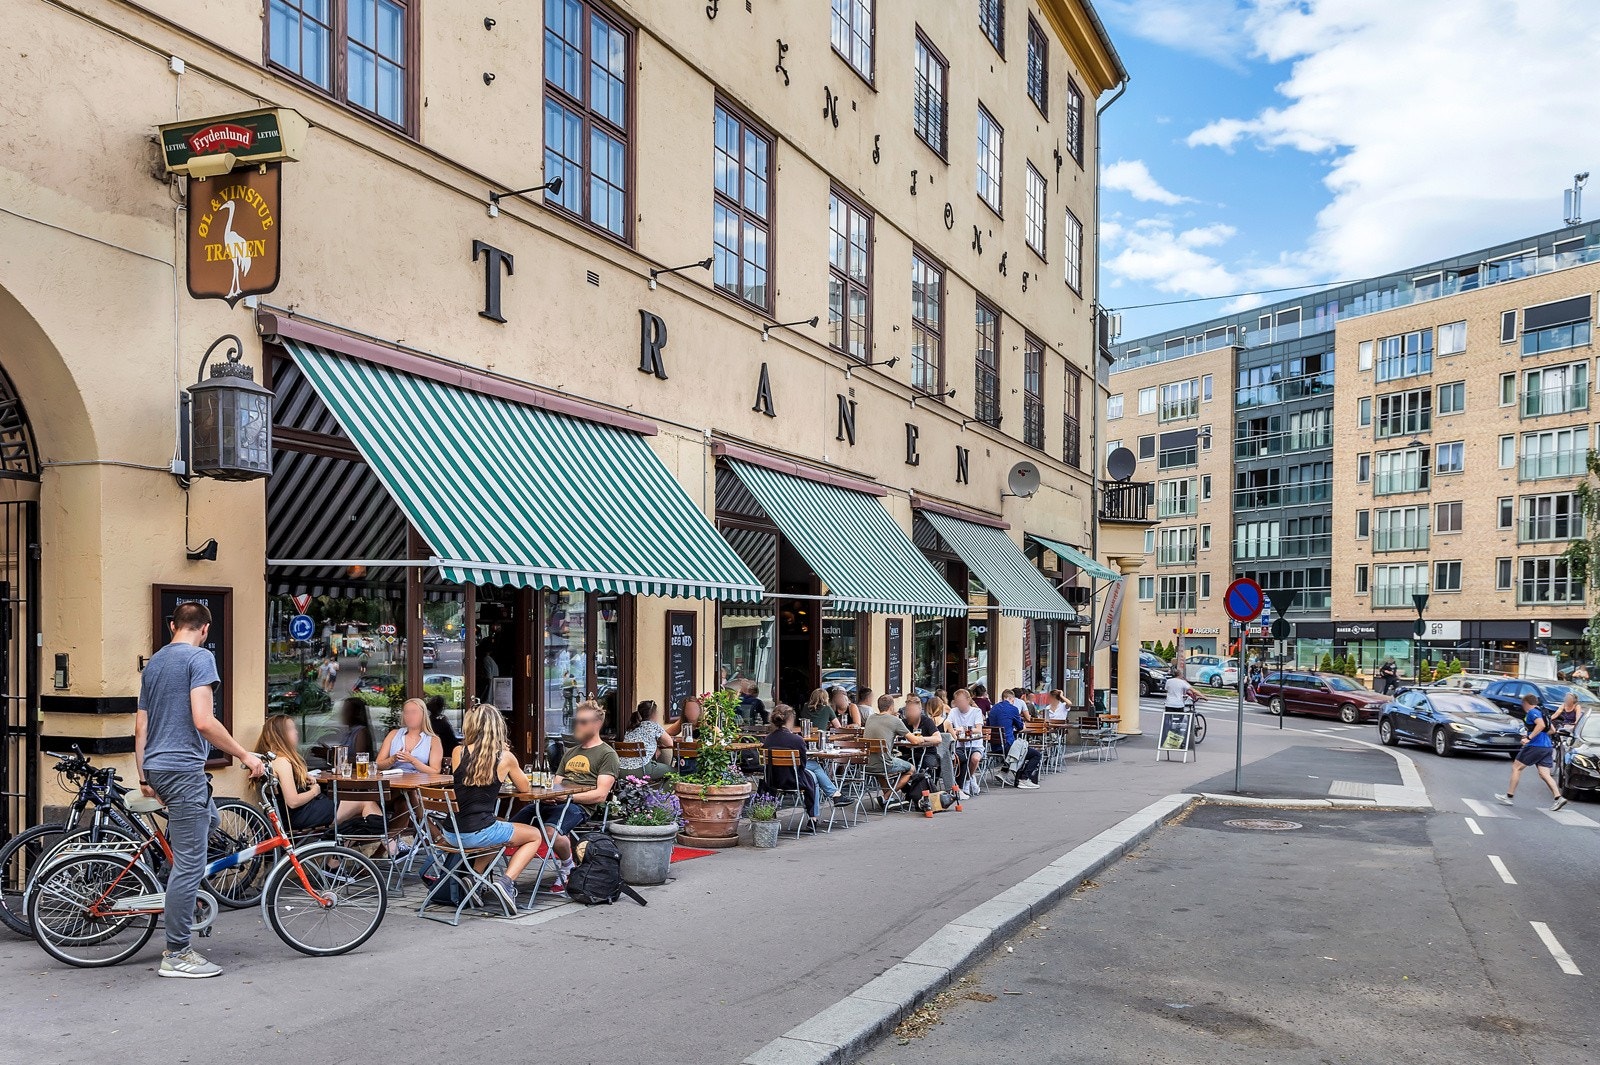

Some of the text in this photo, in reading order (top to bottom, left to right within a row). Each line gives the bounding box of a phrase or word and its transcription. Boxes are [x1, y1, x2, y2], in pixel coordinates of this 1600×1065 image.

[193, 127, 250, 151] Frydenlund
[198, 185, 274, 238] ØL & VINSTUE
[204, 239, 265, 262] TRANEN
[472, 239, 970, 485] TRANEN
